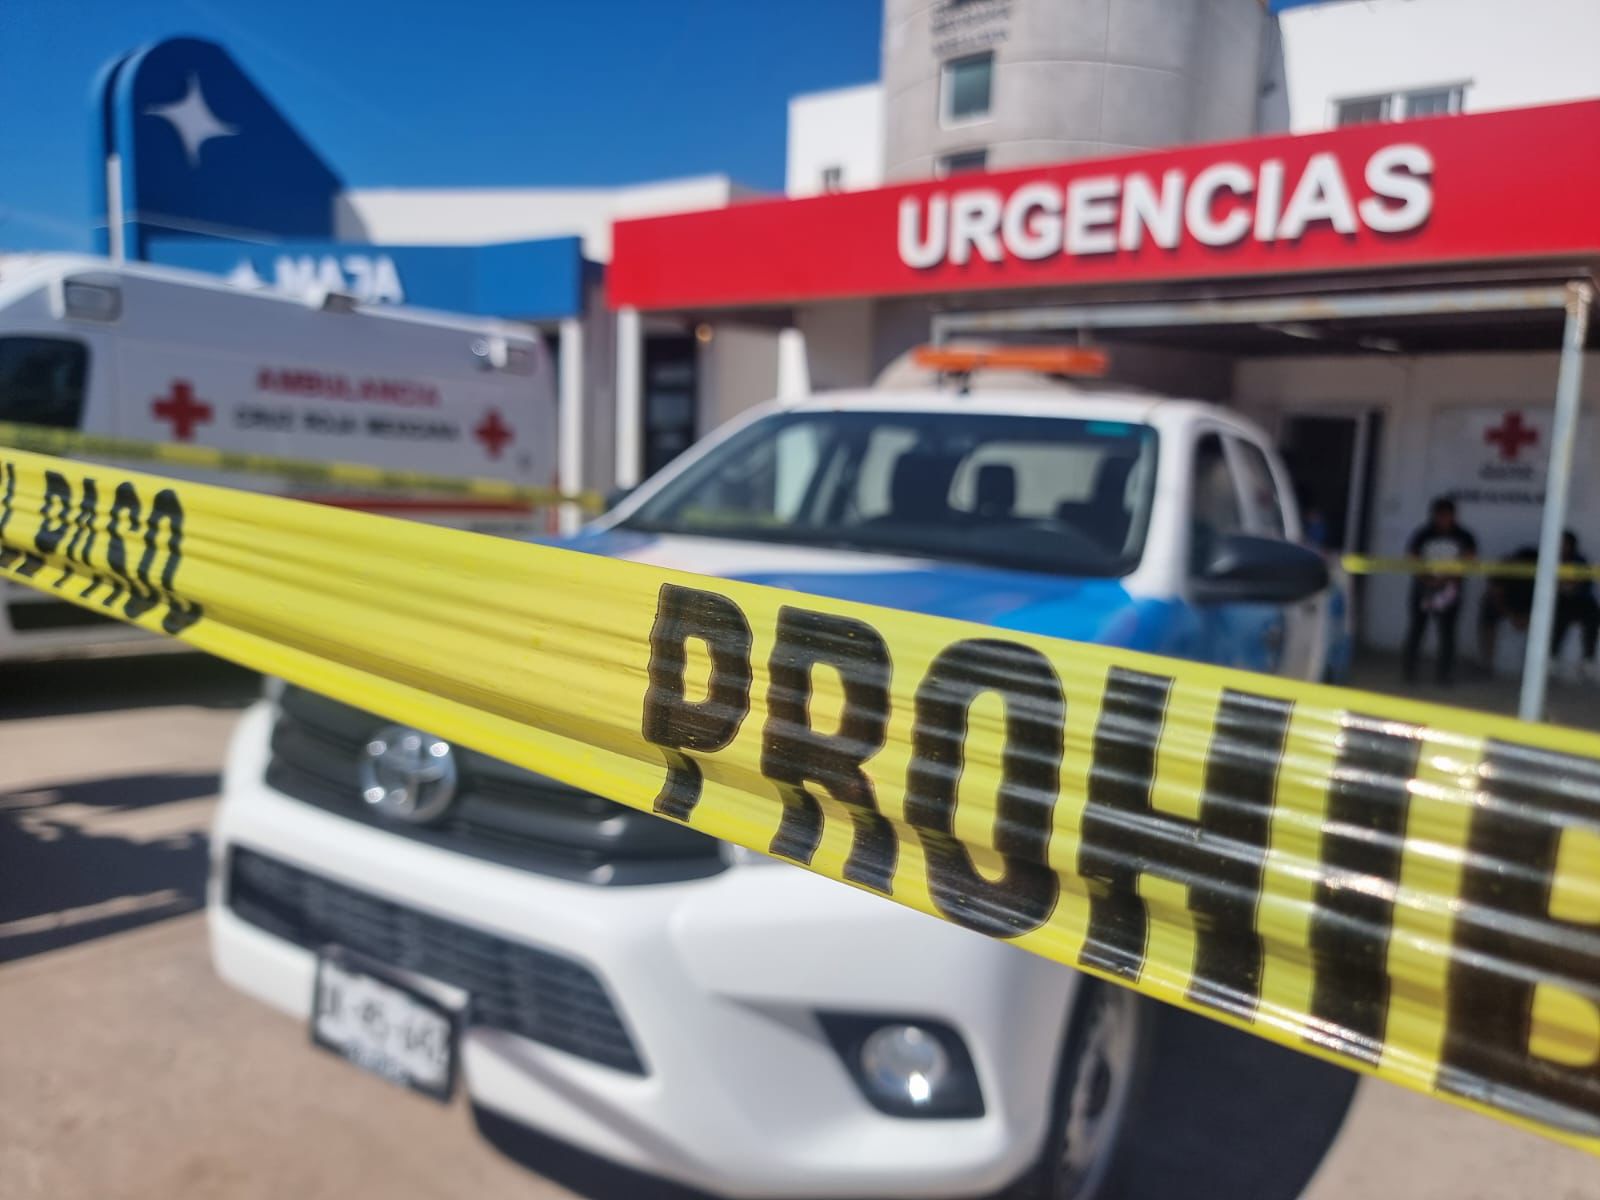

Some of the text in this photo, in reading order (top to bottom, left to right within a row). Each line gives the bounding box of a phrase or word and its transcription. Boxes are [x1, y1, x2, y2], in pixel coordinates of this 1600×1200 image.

[899, 144, 1433, 268] URGENCIAS
[235, 405, 294, 433] CRUZ
[304, 409, 356, 436] ROJA
[256, 367, 441, 408] AMBULANCIA
[35, 469, 204, 635] PASO
